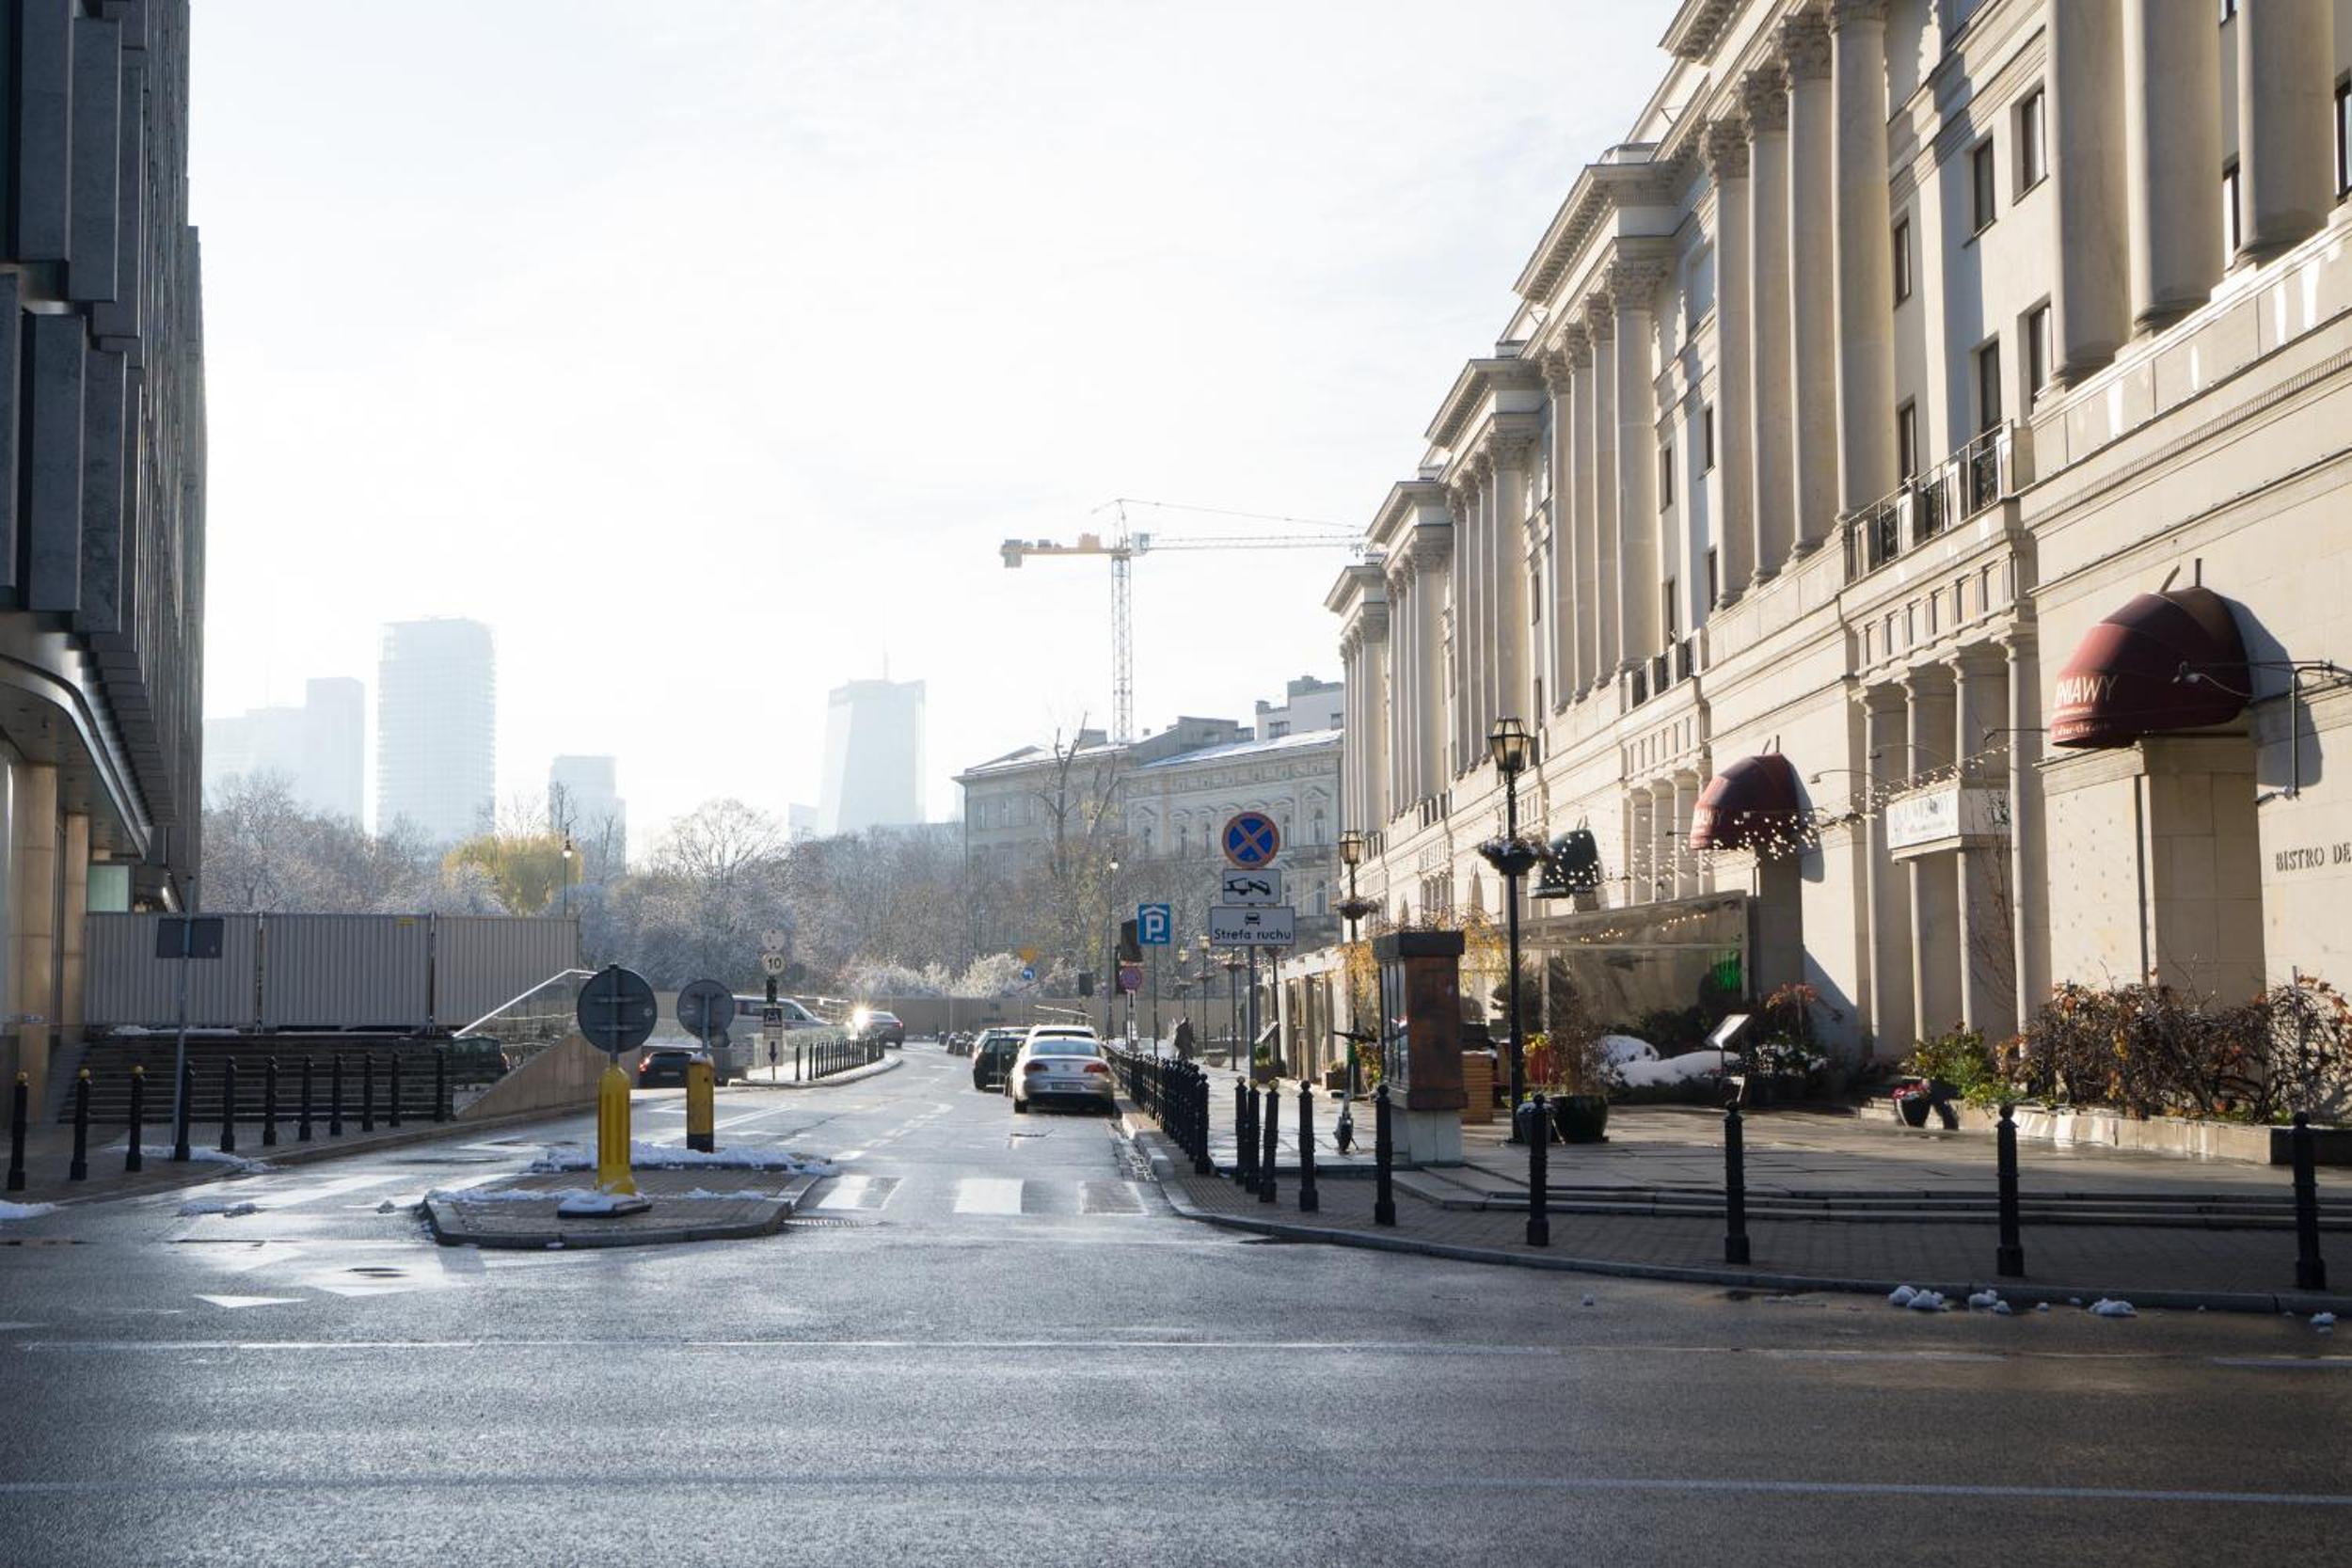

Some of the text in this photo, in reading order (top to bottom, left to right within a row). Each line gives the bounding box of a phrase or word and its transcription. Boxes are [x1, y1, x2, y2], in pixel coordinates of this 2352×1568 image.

[2276, 847, 2325, 871] BISTRO
[1146, 914, 1164, 941] P
[1215, 928, 1292, 940] Strefa ruchu
[768, 957, 782, 970] 10
